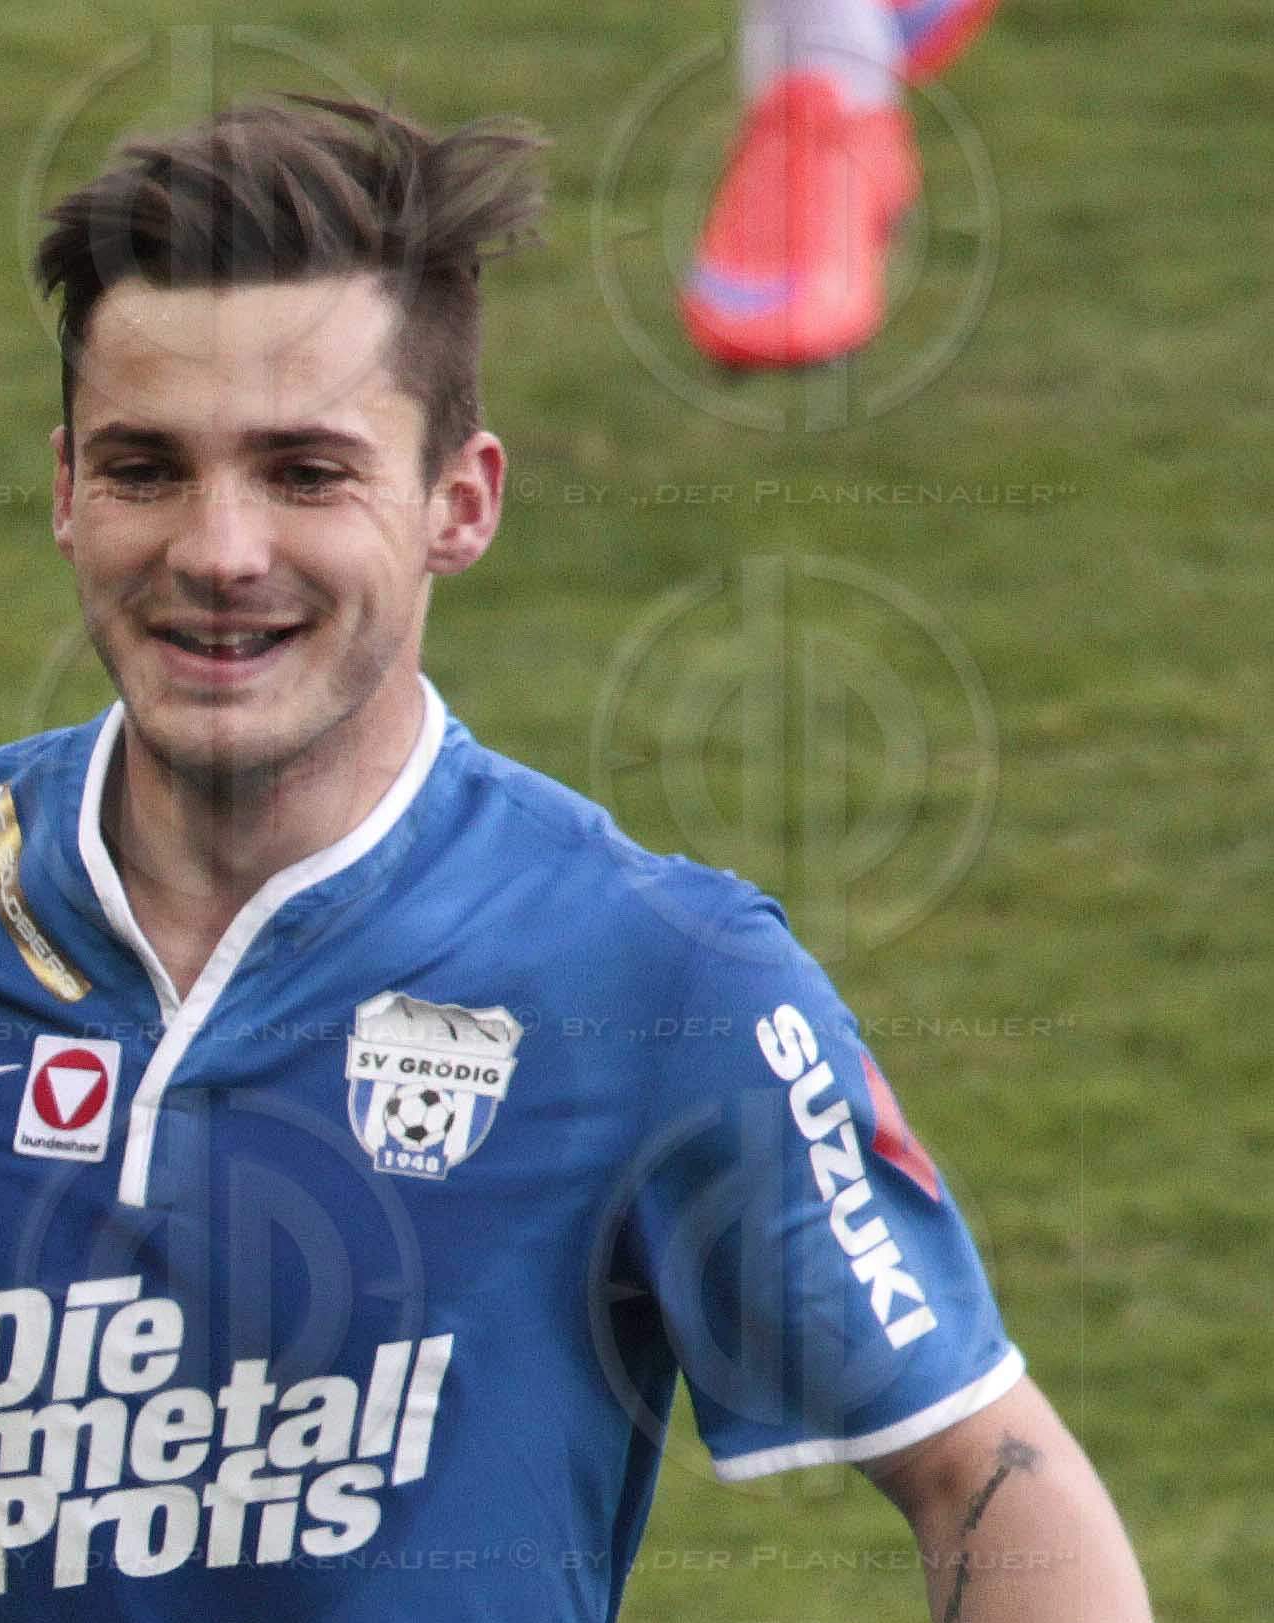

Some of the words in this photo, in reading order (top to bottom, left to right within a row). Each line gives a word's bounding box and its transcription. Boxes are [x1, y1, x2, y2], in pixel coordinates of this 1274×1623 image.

[359, 1053, 388, 1068] SV
[385, 1151, 440, 1172] 1948
[756, 1003, 939, 1350] SUZUKI
